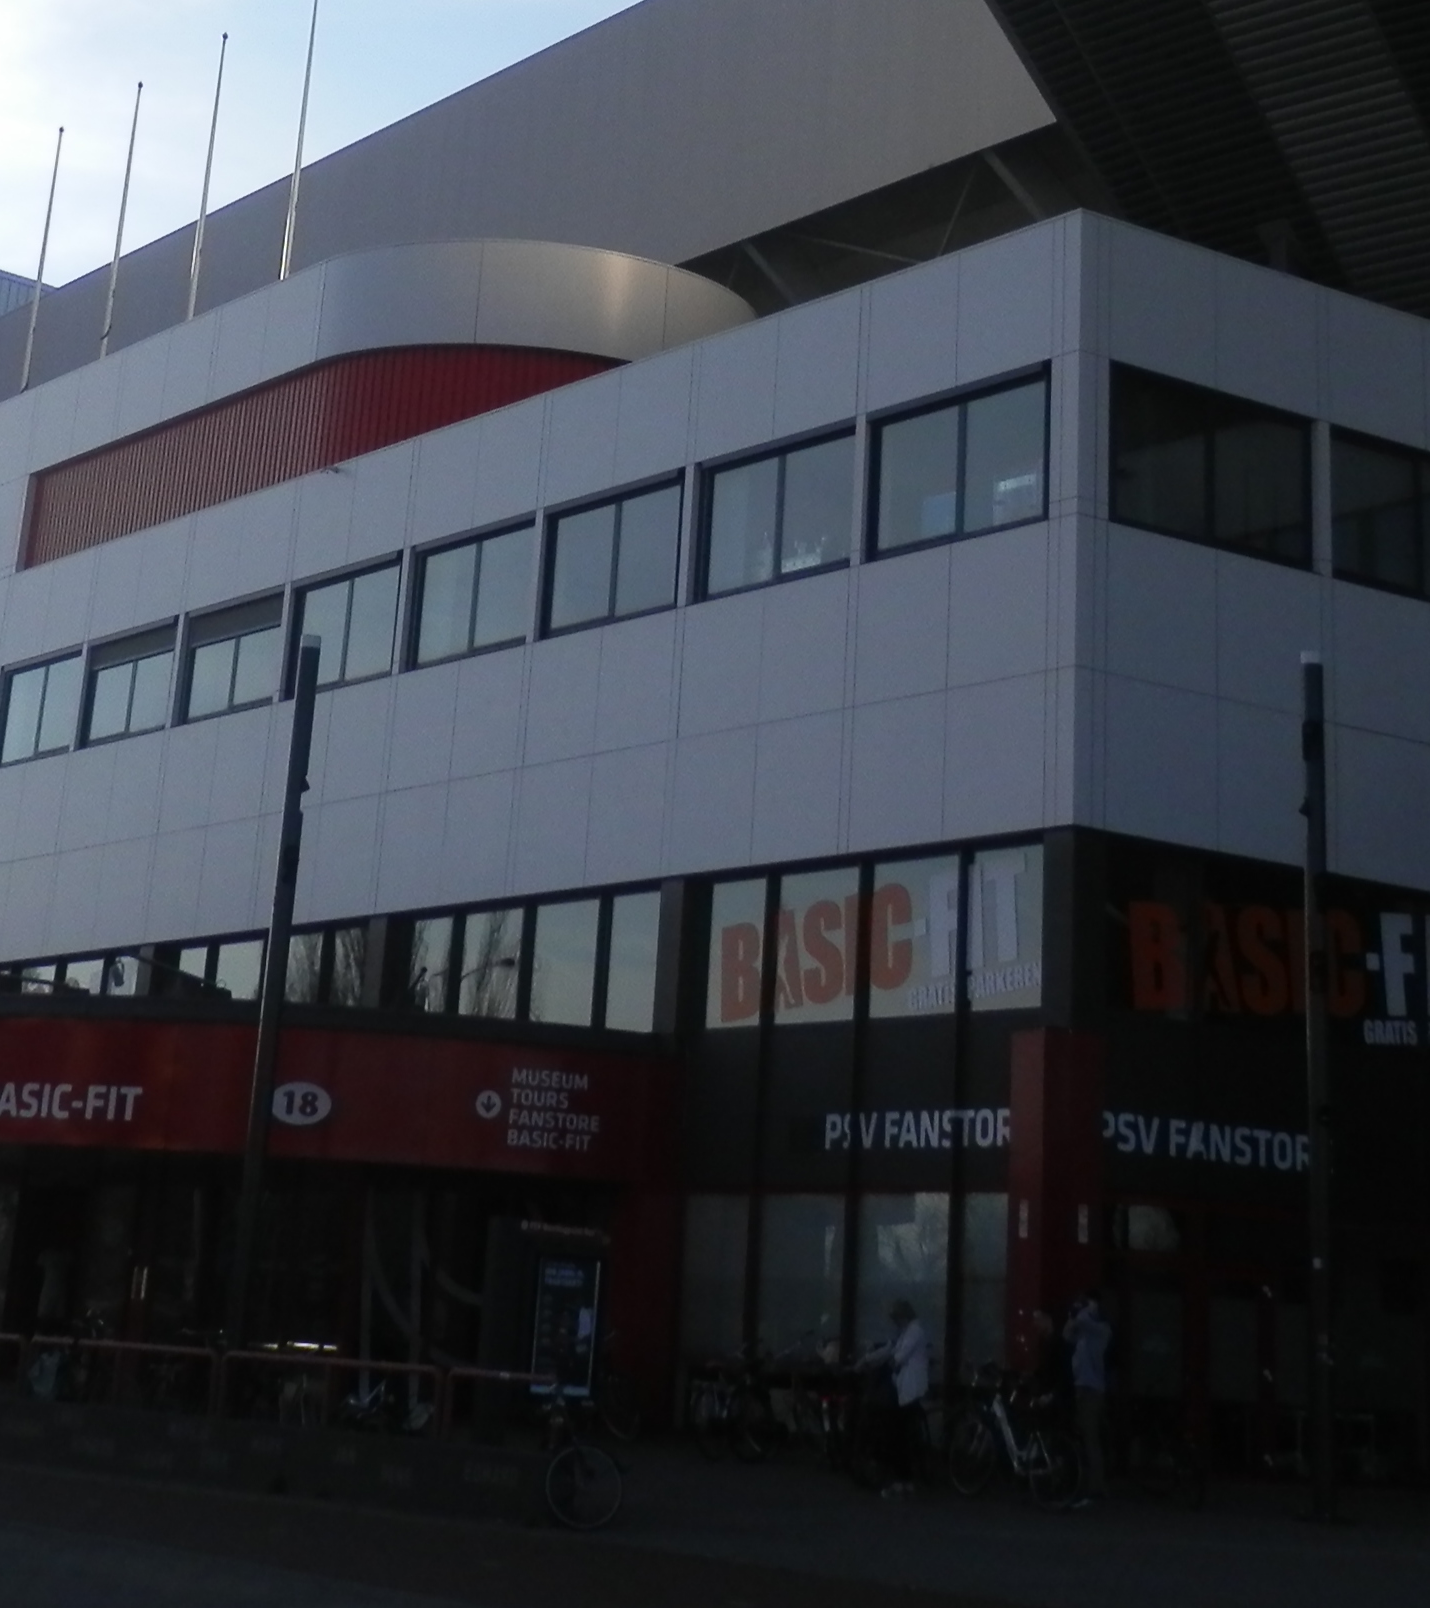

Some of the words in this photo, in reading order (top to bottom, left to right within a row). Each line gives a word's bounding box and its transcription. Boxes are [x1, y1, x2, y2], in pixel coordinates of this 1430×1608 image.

[720, 850, 1027, 1023] BASIC-FIT
[1362, 1018, 1418, 1047] GRATIS
[511, 1067, 589, 1091] MUSEUM
[282, 1089, 319, 1117] 18
[510, 1088, 570, 1109] TOURS
[508, 1108, 601, 1132] FANSTORE
[824, 1111, 878, 1151] PSV
[507, 1129, 591, 1153] BASIC-FIT
